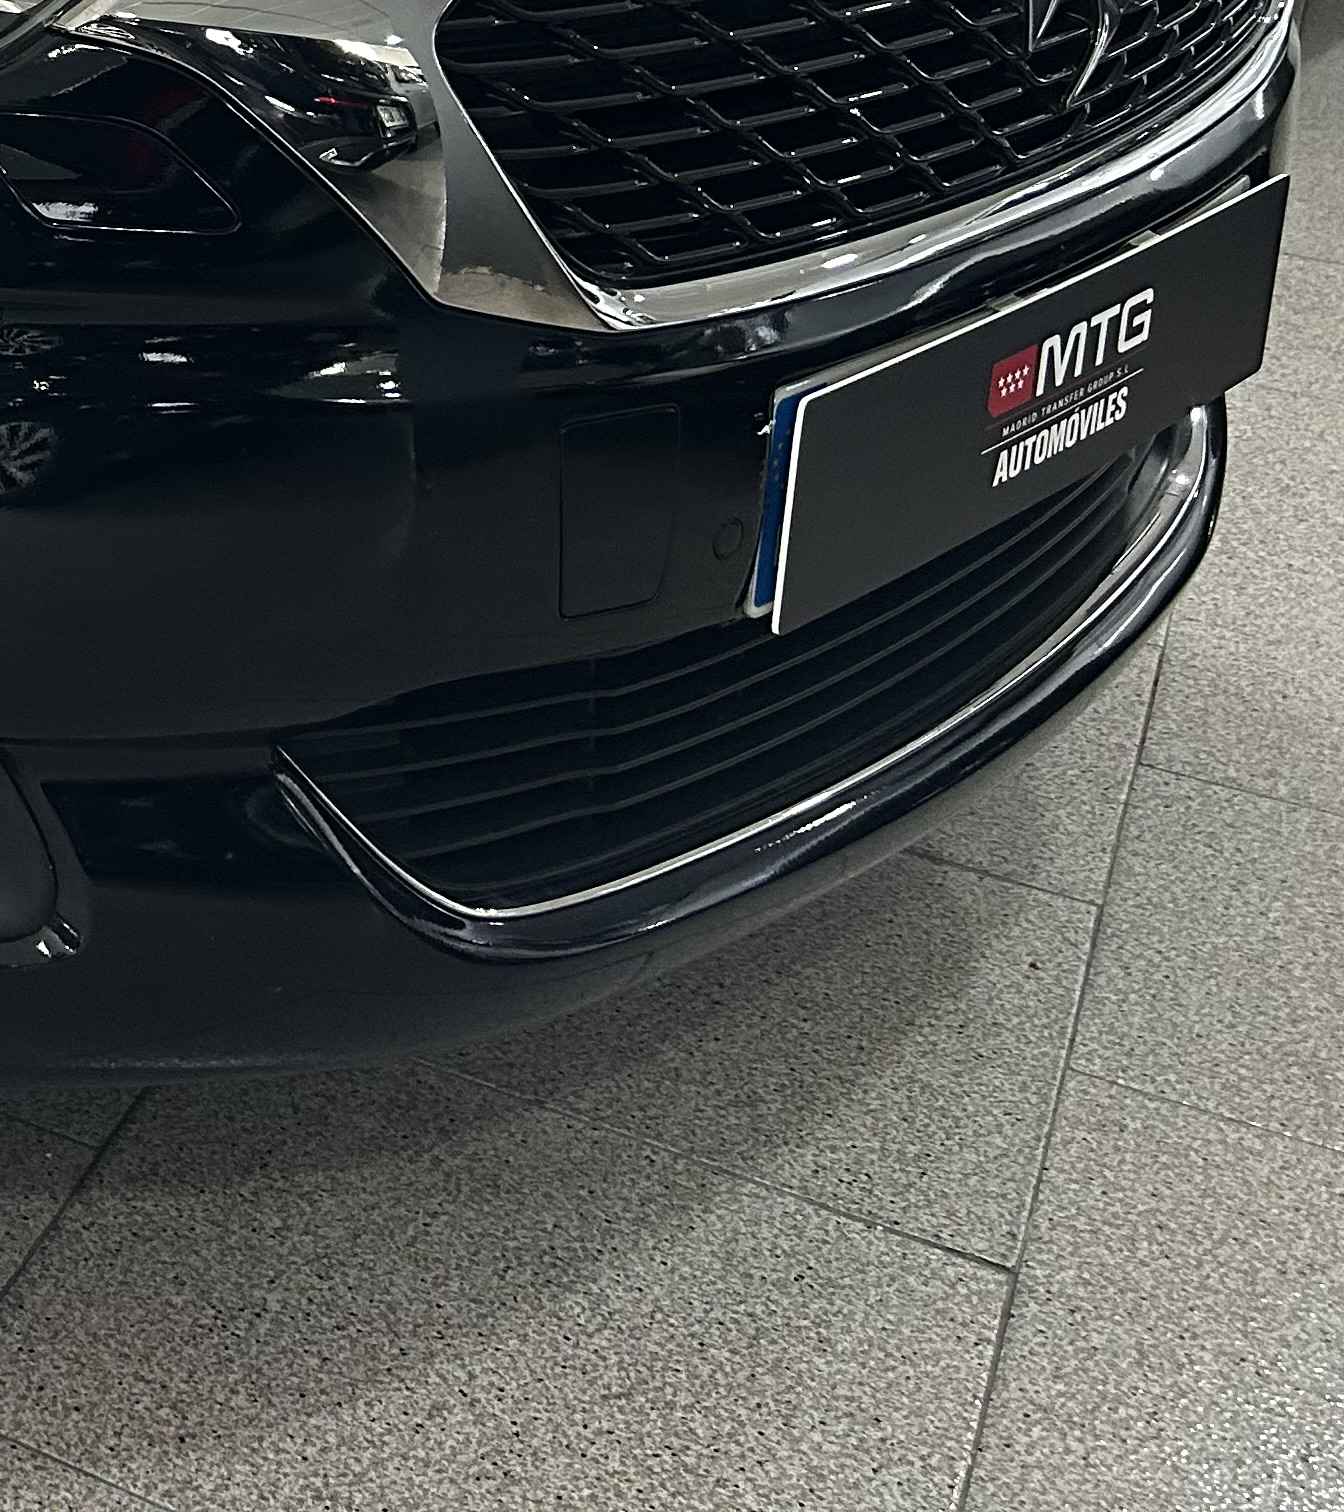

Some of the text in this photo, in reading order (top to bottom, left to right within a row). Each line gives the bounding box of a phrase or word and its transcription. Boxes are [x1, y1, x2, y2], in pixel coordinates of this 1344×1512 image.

[1035, 287, 1155, 397] MTG
[991, 386, 1129, 488] AUTOMÓVILES
[1001, 411, 1038, 438] MADRID
[1040, 386, 1085, 417] TRANSFER
[1087, 371, 1114, 394] GROUP
